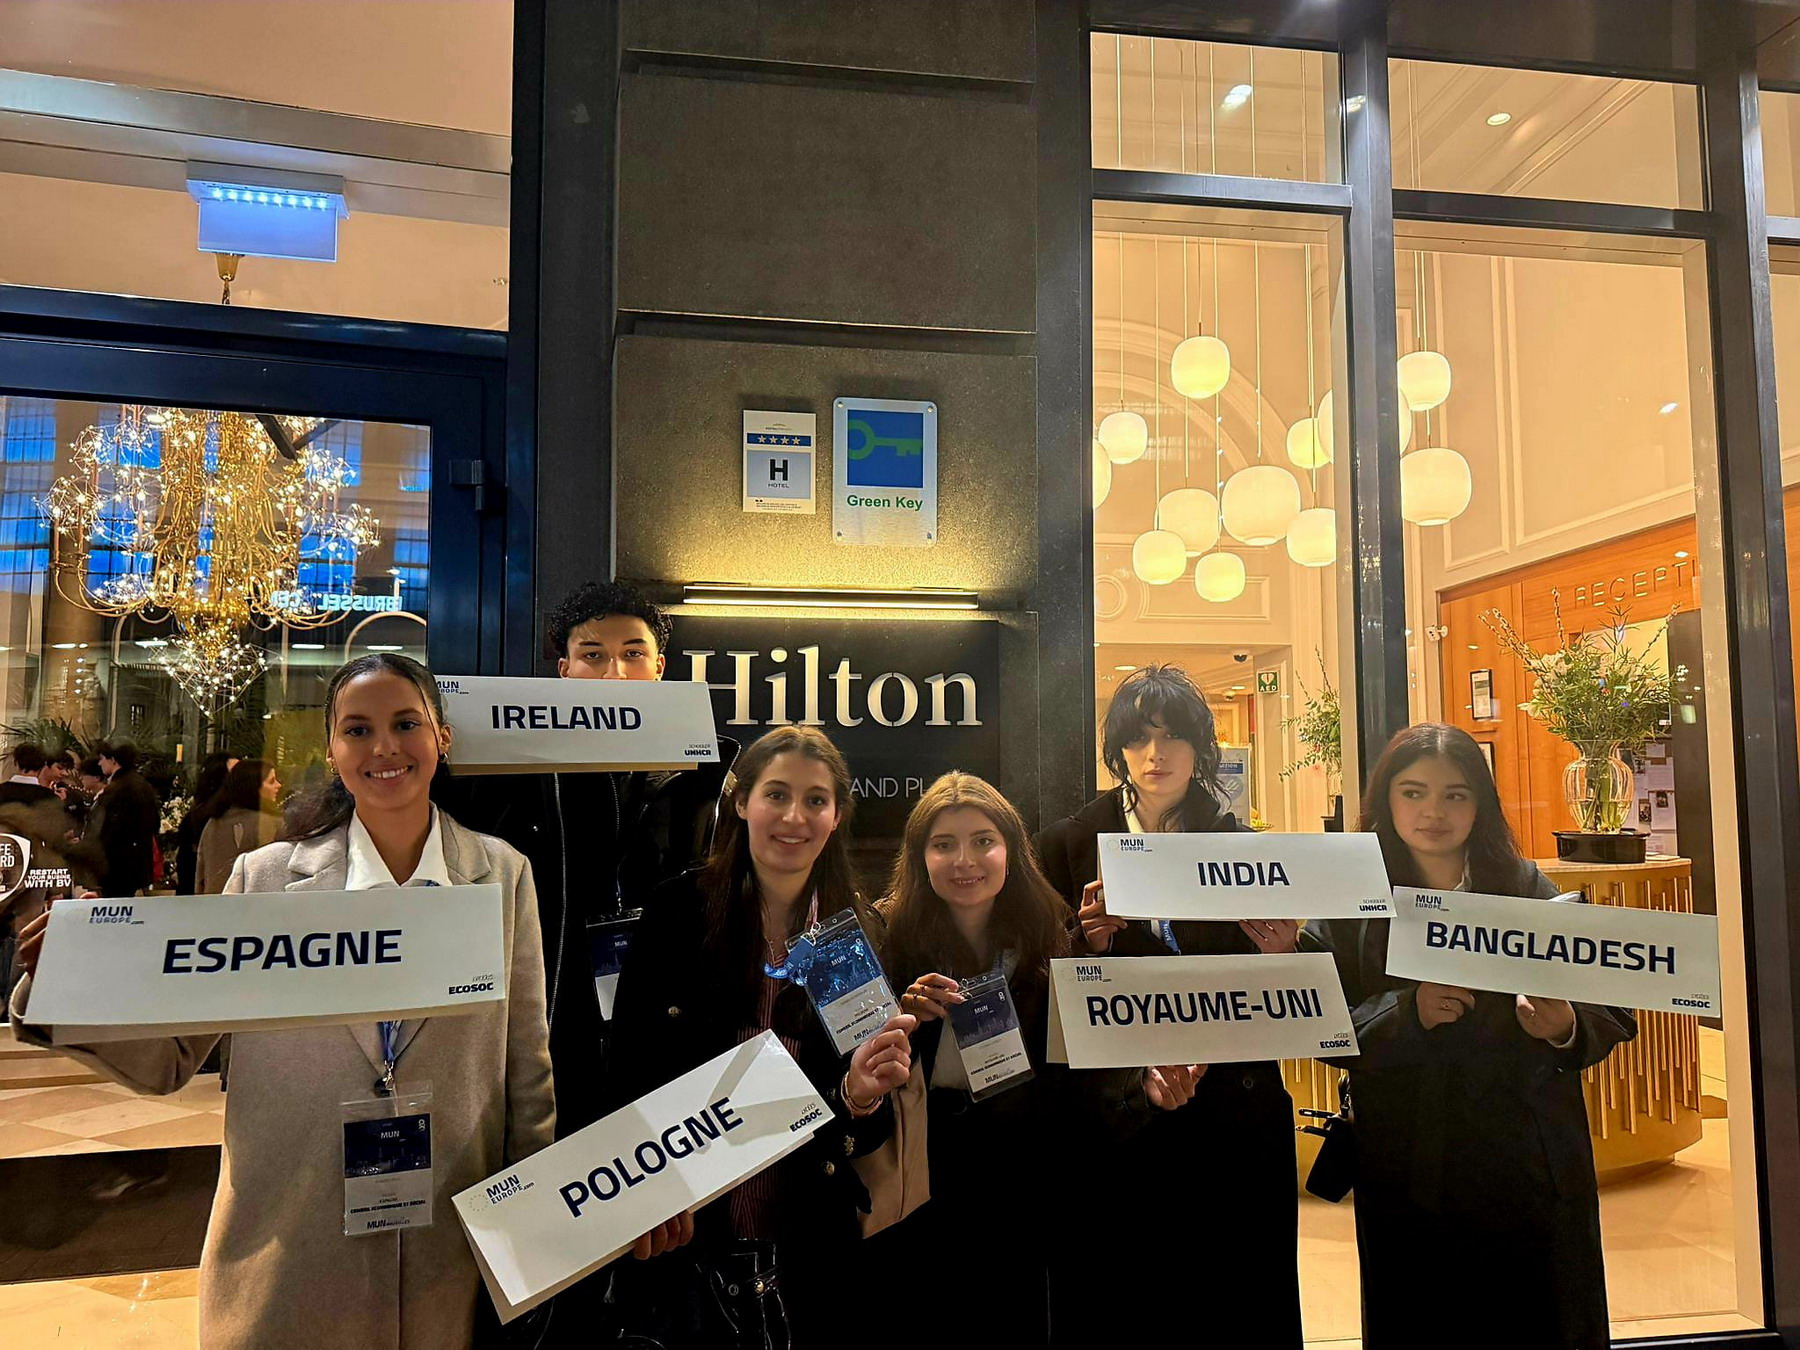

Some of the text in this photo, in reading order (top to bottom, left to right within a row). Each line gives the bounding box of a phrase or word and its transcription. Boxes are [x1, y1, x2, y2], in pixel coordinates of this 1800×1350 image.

[770, 459, 788, 481] H
[847, 495, 923, 511] Green Key
[682, 644, 983, 727] Hilton
[491, 705, 642, 730] IRELAND
[1120, 839, 1144, 847] MUN
[1197, 862, 1290, 886] INDIA
[24, 879, 72, 888] WITH BV
[1415, 894, 1442, 905] MUN
[91, 906, 133, 917] MUN
[162, 929, 403, 974] ESPAGNE
[1426, 921, 1675, 974] BANGLADESH
[831, 955, 847, 967] MUN
[1076, 966, 1102, 975] MUN
[448, 982, 494, 995] ECOSOC
[1086, 988, 1323, 1026] ROYAUME-UNI
[1672, 998, 1711, 1008] ECOSOC
[1320, 1040, 1351, 1049] ECOSOC
[789, 1108, 822, 1132] ECOSOC
[380, 1130, 400, 1139] MUN
[558, 1097, 743, 1218] POLOGNE
[486, 1174, 520, 1198] MUN
[367, 1219, 386, 1229] MUN
